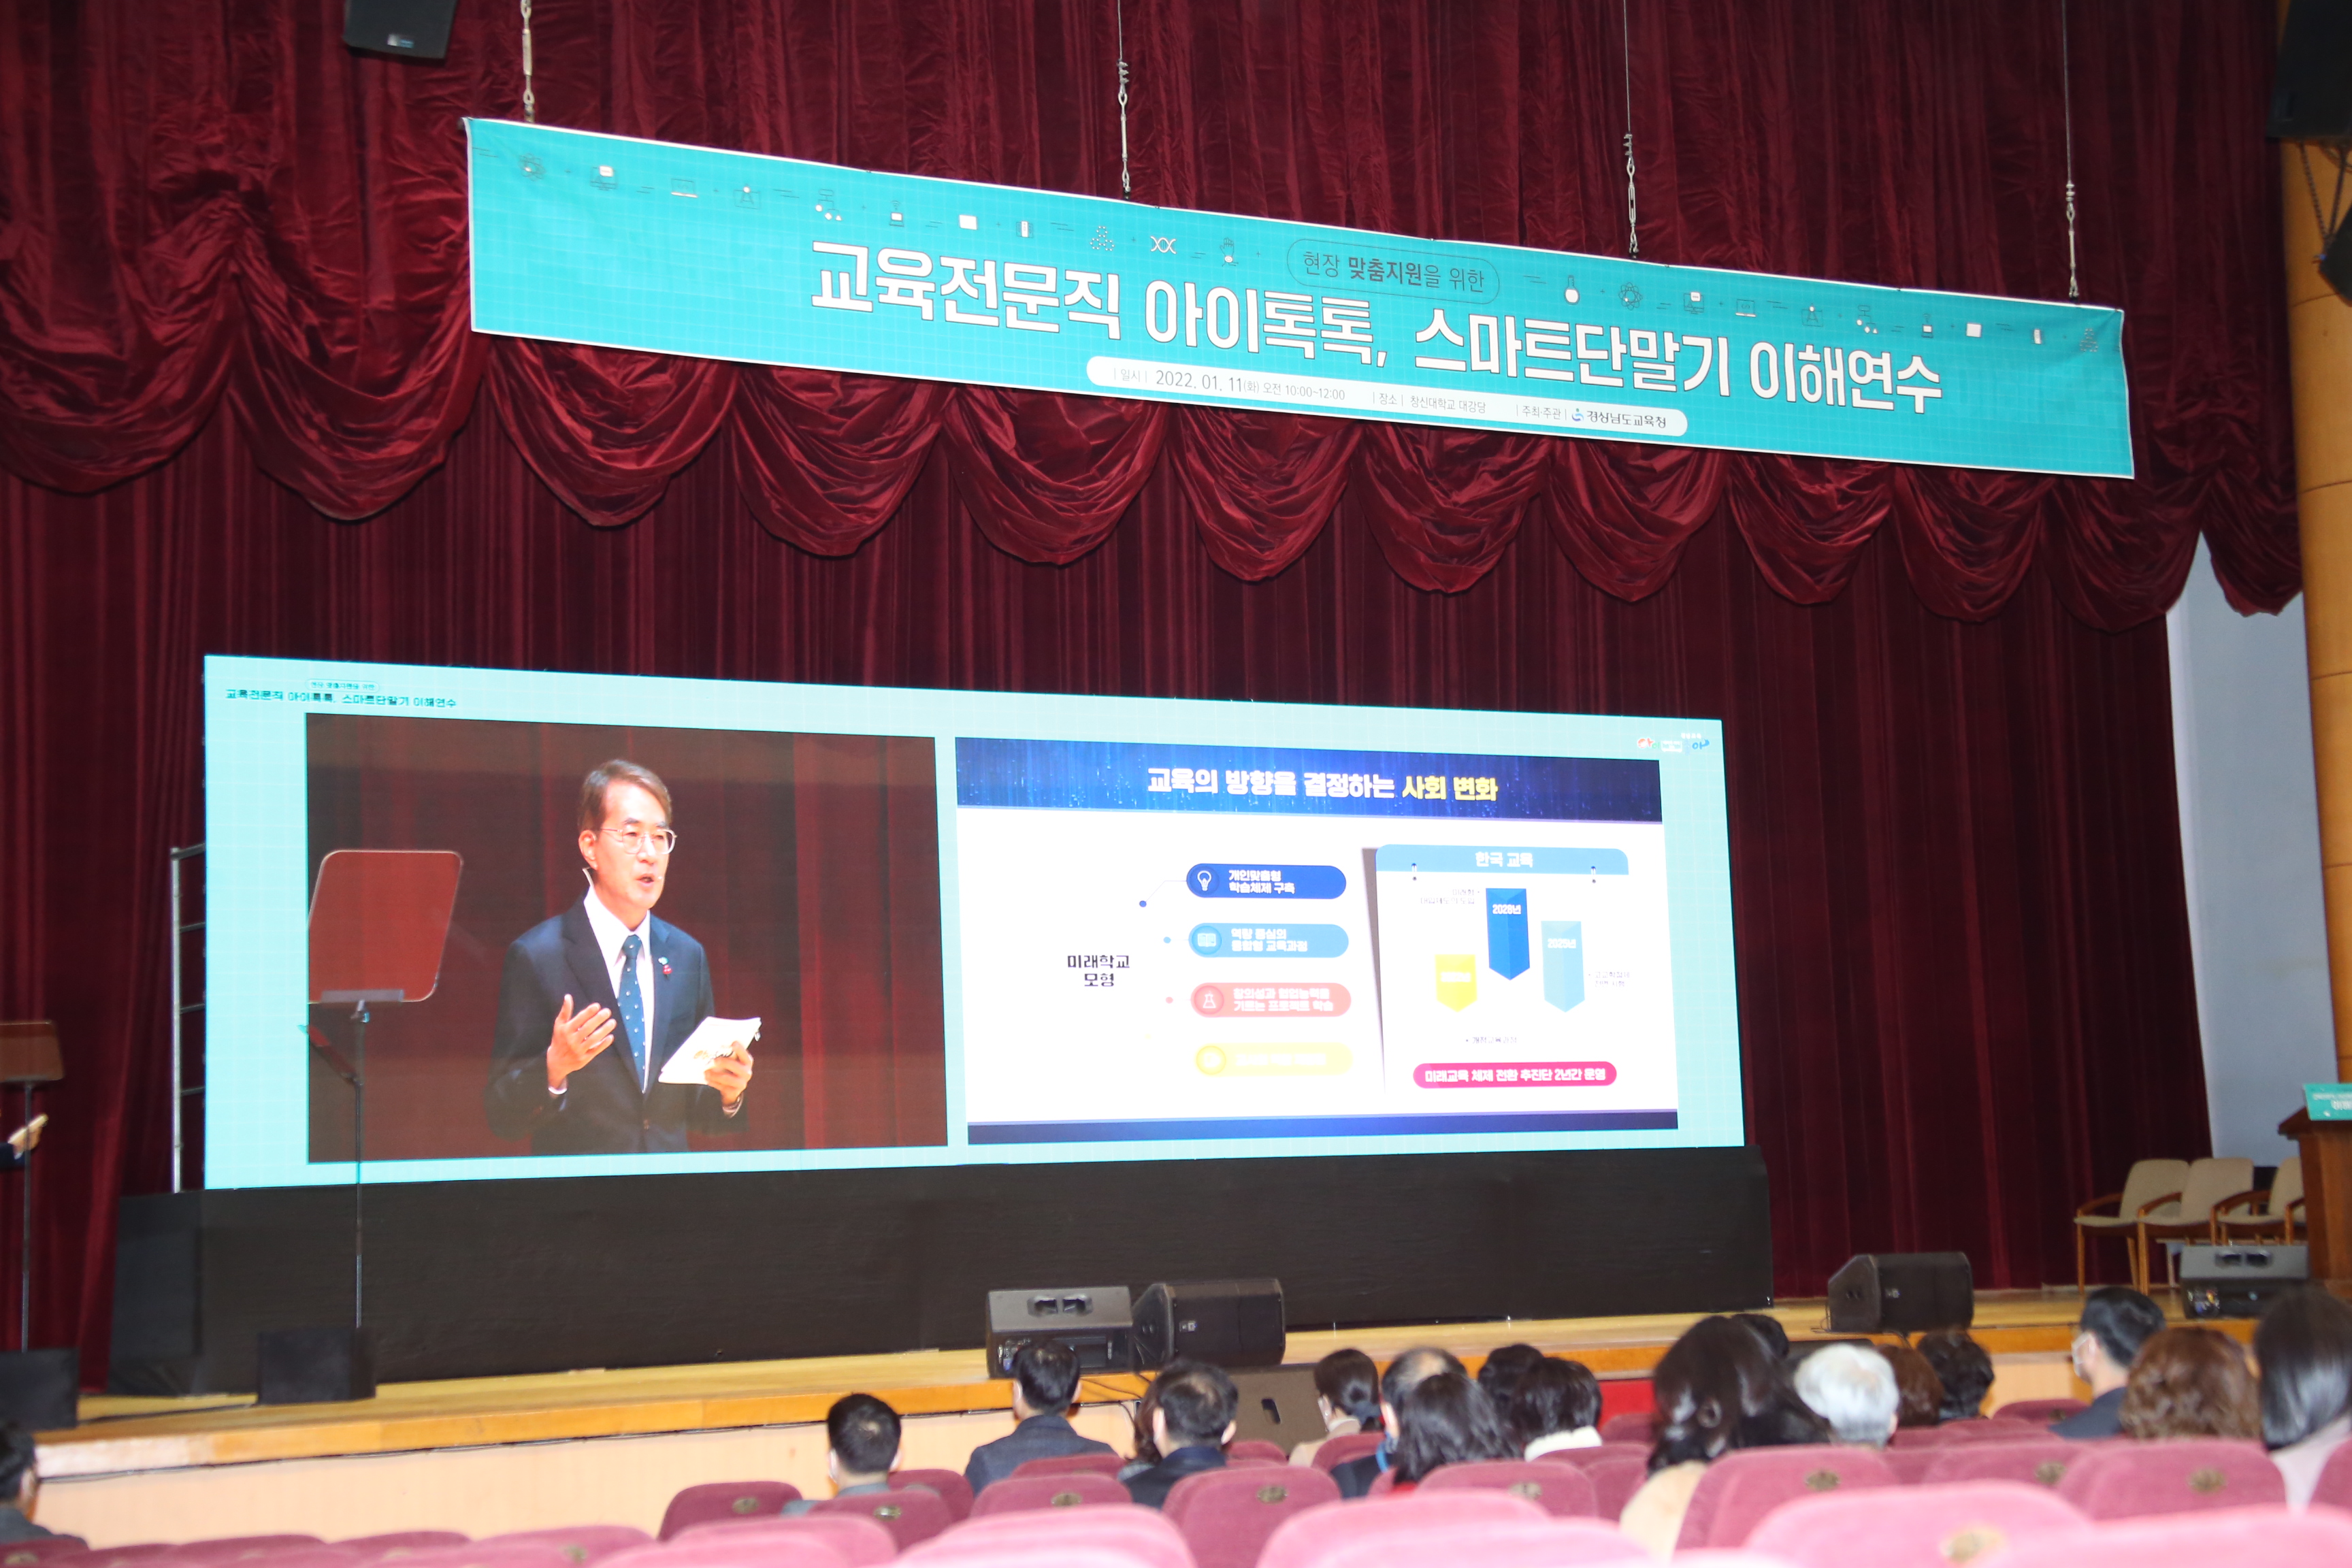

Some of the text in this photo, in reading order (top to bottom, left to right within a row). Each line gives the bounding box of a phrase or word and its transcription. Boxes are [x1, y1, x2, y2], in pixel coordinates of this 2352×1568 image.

[1303, 251, 1484, 293] 현장 맞춤지원을 위한
[811, 240, 1943, 414] 교육전문직 아이톡톡, 스마트단말기 이해연수
[1120, 368, 1141, 382] 일시
[1156, 370, 1197, 389] 2022.
[1202, 375, 1222, 392] 01.
[1262, 382, 1281, 396] 오전
[1285, 385, 1345, 401] 10:00~12:00
[1379, 392, 1486, 414] 장소 창신대학교 대강당
[1586, 409, 1667, 429] 경상남도교육청
[1147, 768, 1499, 802] 교육의 방향을 결정하는 사회 변화
[1475, 851, 1534, 868] 한국 교육
[1228, 882, 1296, 894] 학습체제 구축
[1266, 940, 1308, 952] 교육과정
[1067, 955, 1130, 968] 미래학교
[1084, 973, 1114, 987] 모형
[1233, 1000, 1266, 1012] 기르는
[1424, 1068, 1606, 1082] 미래교육 체제 전환 추진단 2년간 운영
